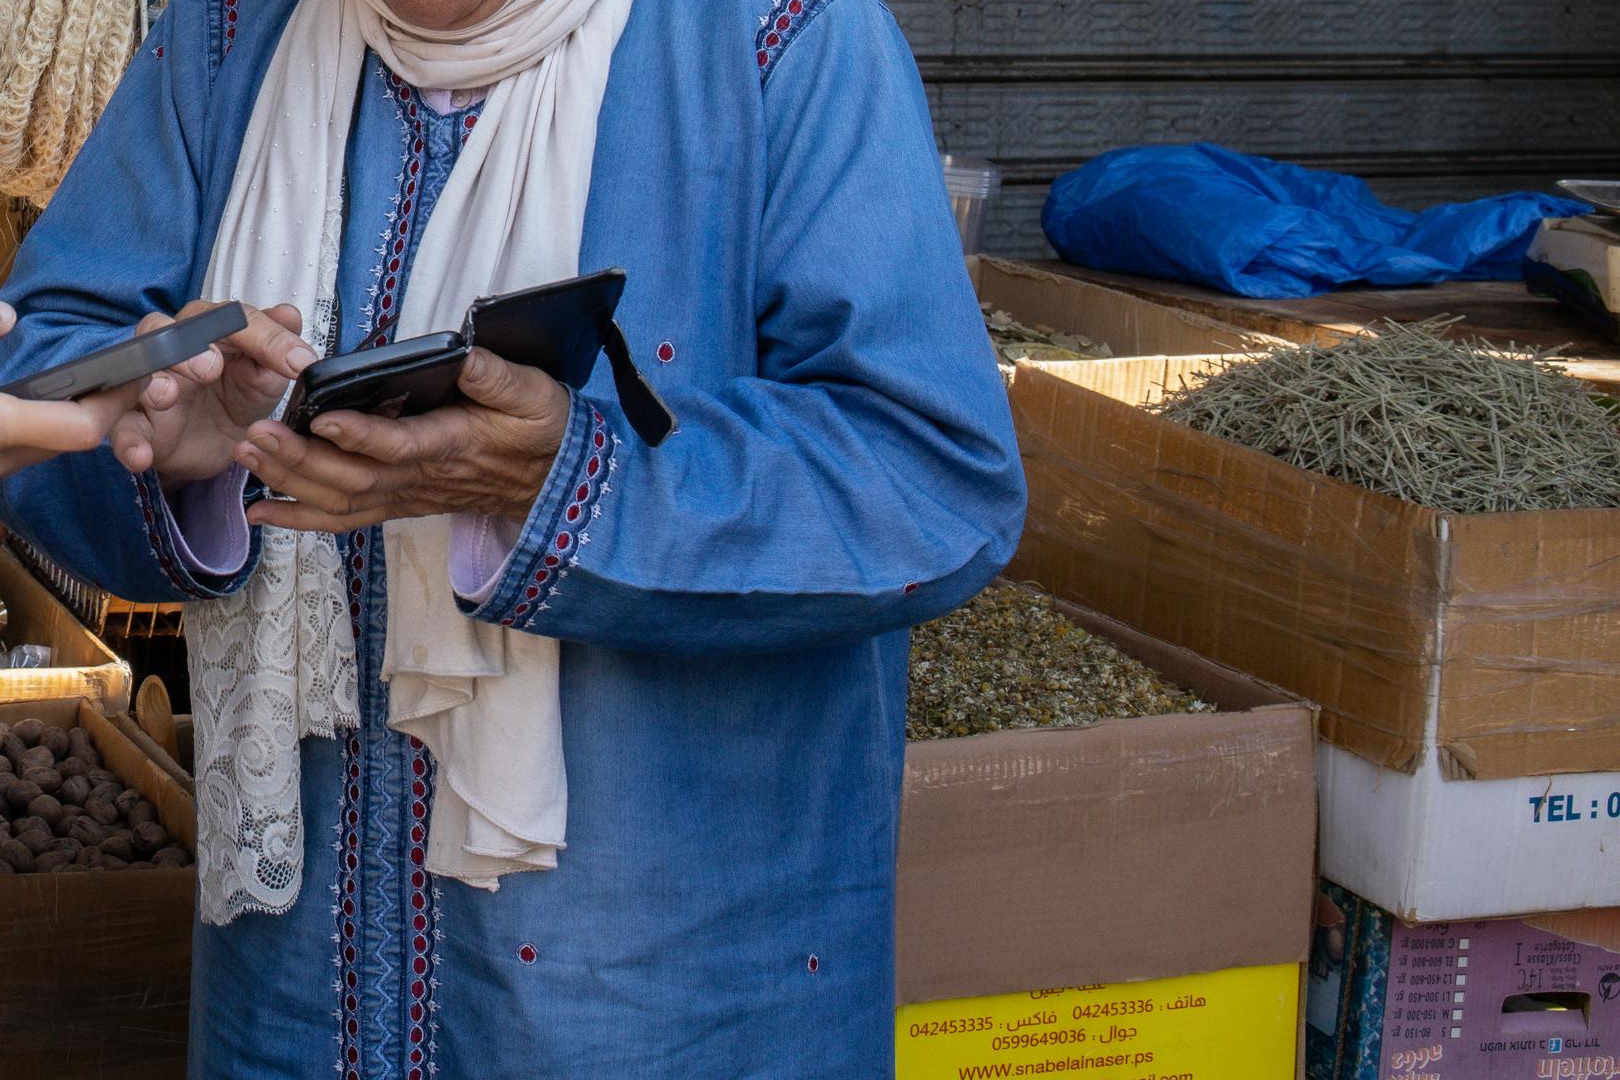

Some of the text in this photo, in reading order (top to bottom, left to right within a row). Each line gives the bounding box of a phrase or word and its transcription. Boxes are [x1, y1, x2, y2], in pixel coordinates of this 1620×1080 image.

[1529, 794, 1581, 822] TEL
[1534, 939, 1576, 952] Categorie
[1526, 953, 1582, 966] Class/Klasse
[1410, 974, 1441, 985] 450-600
[1442, 973, 1452, 984] L2
[1167, 992, 1207, 1011] هاتف
[1408, 992, 1440, 1003] 300-450
[1441, 991, 1451, 1002] L1
[1072, 999, 1155, 1021] 042453336
[1406, 1010, 1437, 1021] 150-300
[1442, 1009, 1450, 1019] M
[910, 1016, 994, 1039] 042453335
[1007, 1010, 1058, 1032] فاكس
[1099, 1024, 1138, 1044] جوال
[1405, 1028, 1431, 1038] 80-150
[1441, 1027, 1446, 1037] S
[992, 1028, 1086, 1051] 0599649036
[1479, 1041, 1507, 1052] חפשו
[1509, 1040, 1536, 1051] אותנו
[1564, 1038, 1582, 1048] פרי
[1583, 1037, 1601, 1047] דוד
